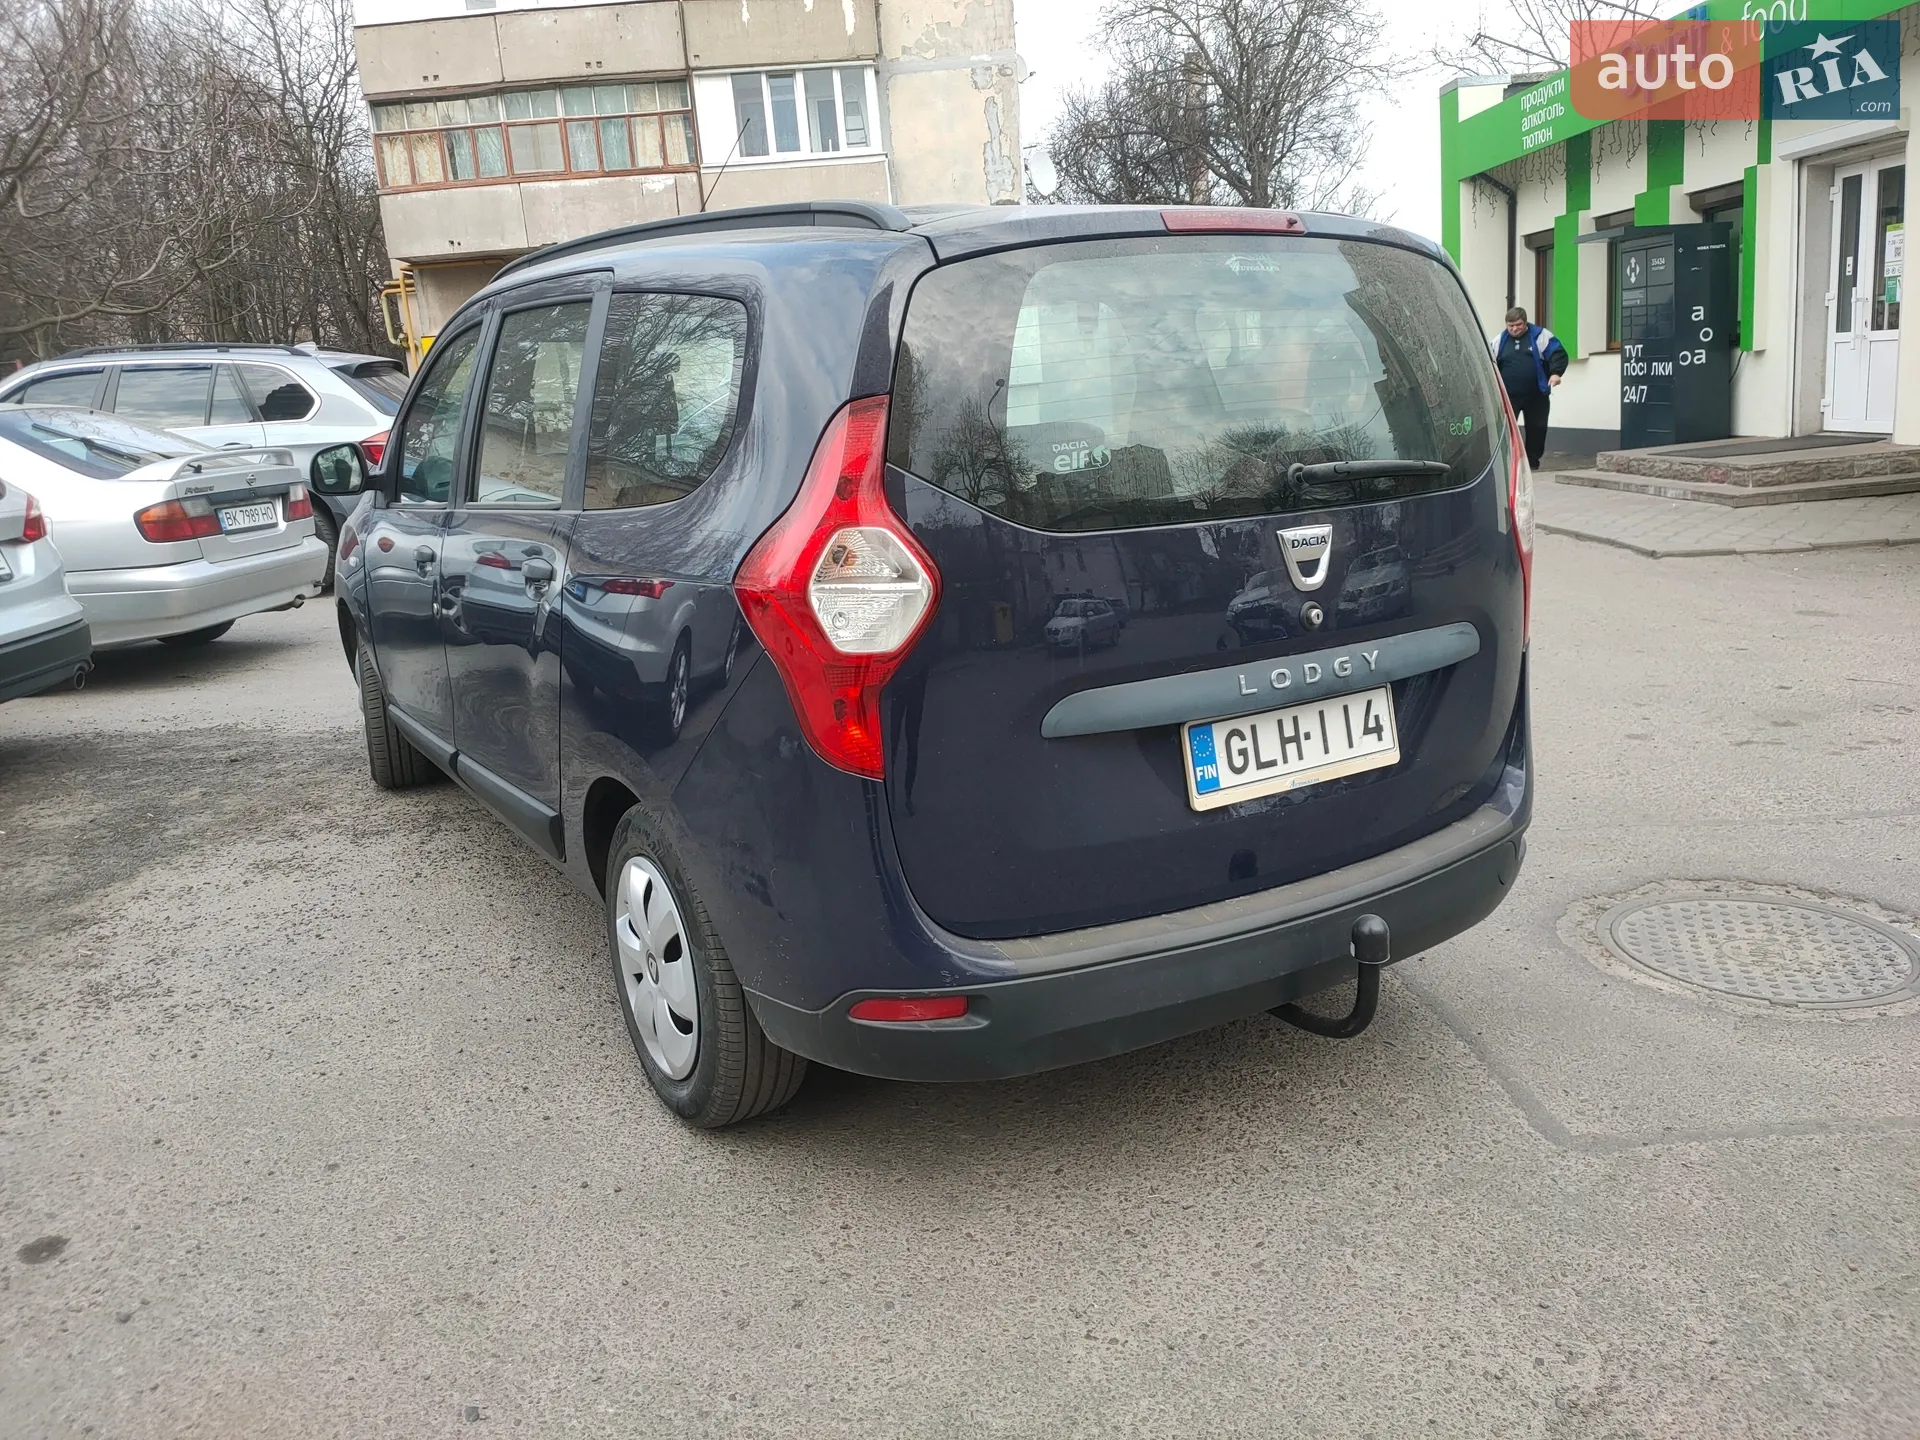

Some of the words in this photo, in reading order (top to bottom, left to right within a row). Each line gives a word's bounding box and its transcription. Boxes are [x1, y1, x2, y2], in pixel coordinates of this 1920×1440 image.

[1720, 26, 1734, 55] &
[1521, 77, 1565, 112] продукти
[1521, 102, 1565, 132] алкоголь
[1521, 126, 1553, 150] тютюн
[1623, 385, 1648, 404] 24/7
[1052, 440, 1089, 453] DACIA
[1053, 450, 1090, 471] elf
[225, 508, 242, 527] BK
[239, 506, 260, 525] 7989
[260, 506, 274, 521] HO
[1291, 535, 1328, 549] DACIA
[1238, 650, 1379, 696] LODGY
[1224, 699, 1384, 775] GLH-114
[1196, 763, 1218, 782] FIN
